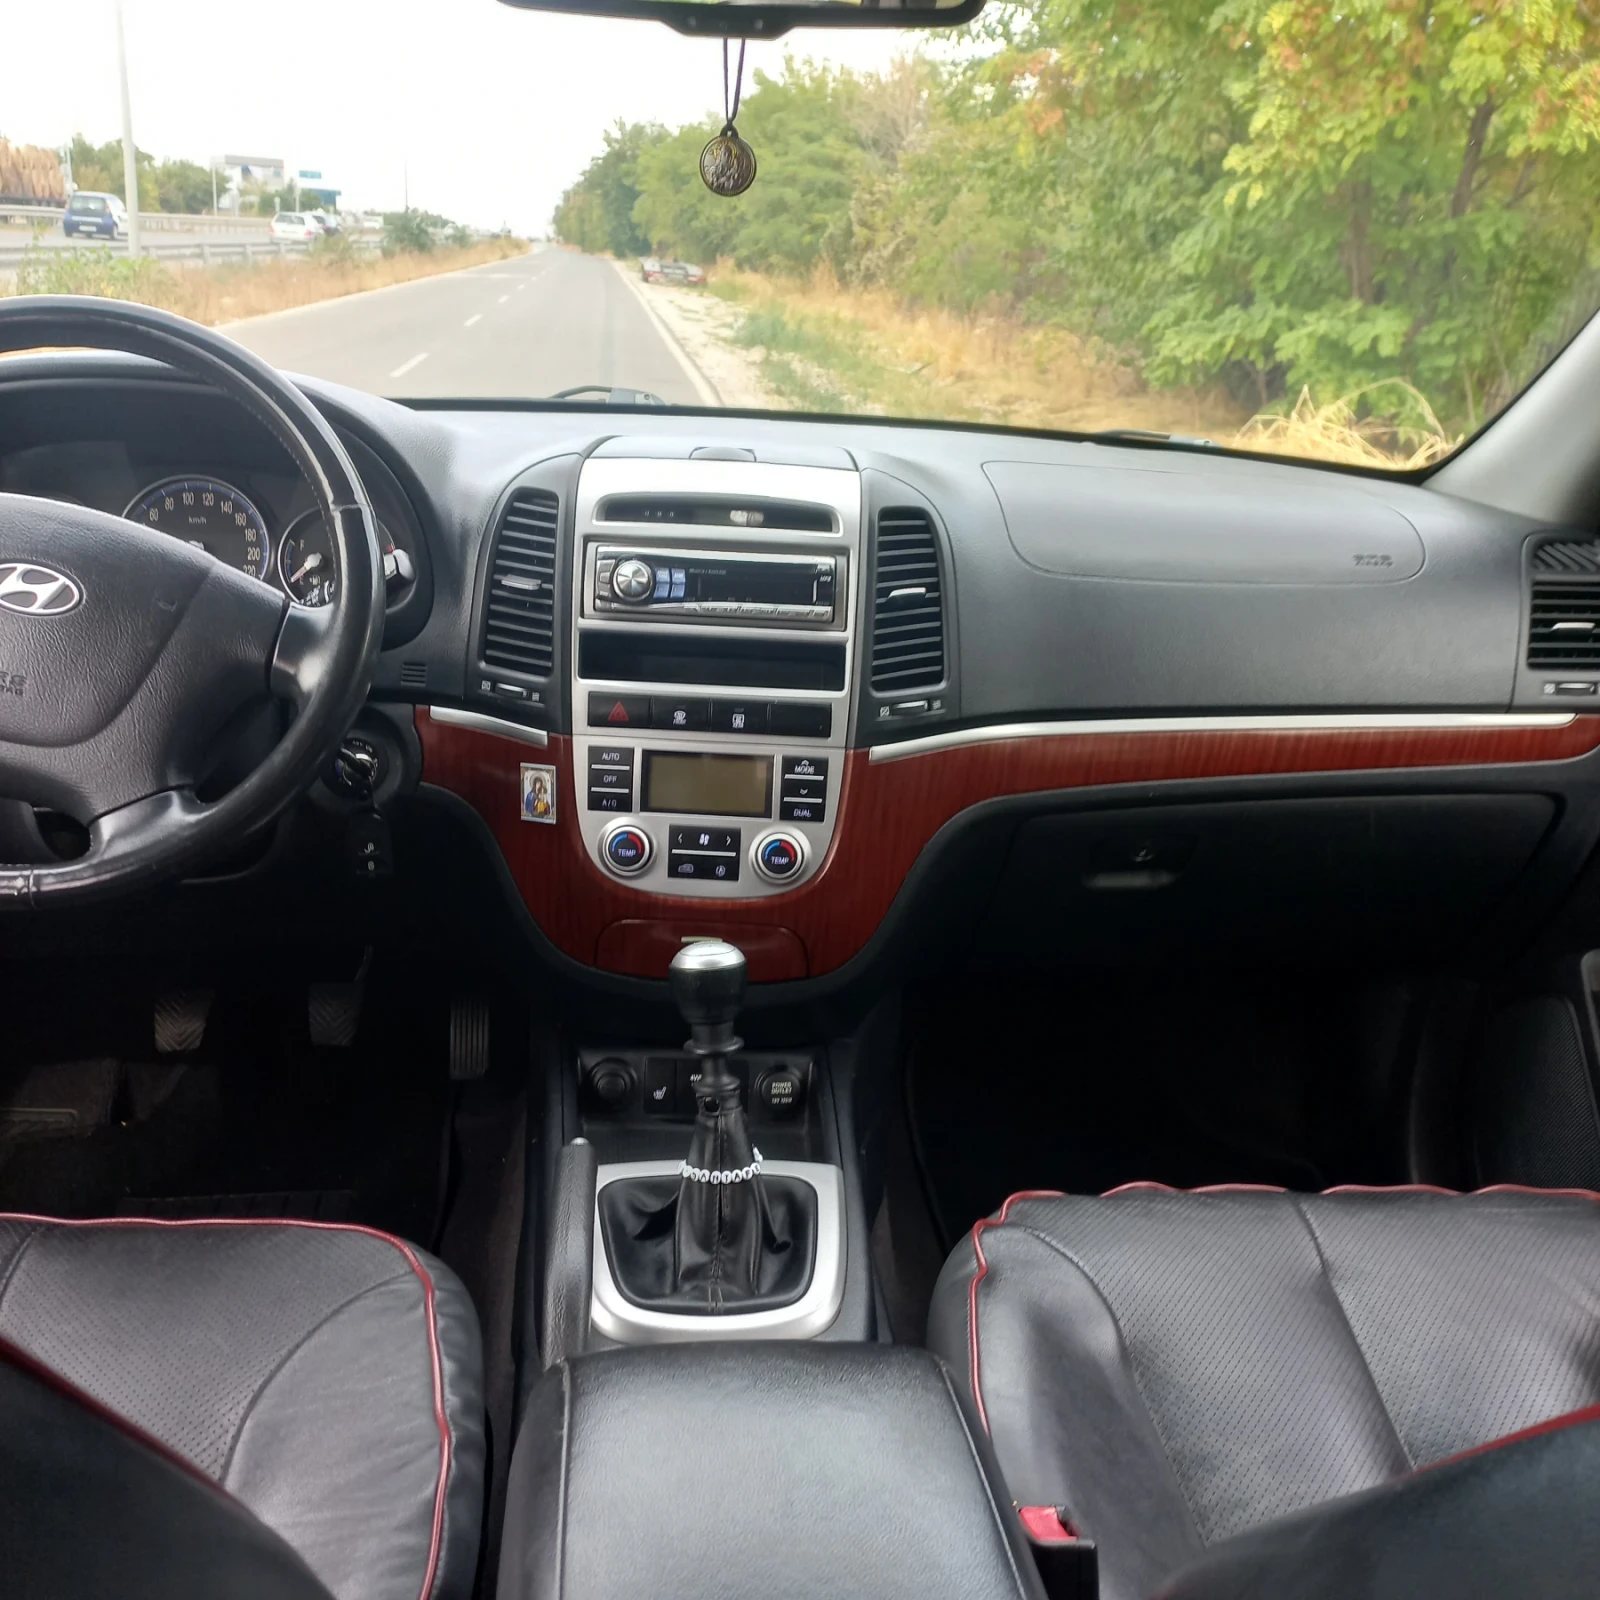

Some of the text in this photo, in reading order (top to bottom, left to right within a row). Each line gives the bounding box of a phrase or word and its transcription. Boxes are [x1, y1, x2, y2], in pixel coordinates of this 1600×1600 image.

[165, 497, 174, 511] 80
[182, 492, 194, 506] 100
[202, 493, 214, 506] 120
[221, 501, 232, 515] 140
[149, 508, 159, 521] 60
[235, 512, 246, 526] 160
[188, 516, 207, 525] km/h
[245, 528, 256, 542] 180
[247, 547, 260, 561] 200
[601, 751, 620, 761] AUTO
[794, 764, 815, 775] MODE
[603, 774, 617, 783] OFF
[793, 808, 812, 818] DUAL
[618, 847, 636, 857] TEMP
[771, 855, 789, 865] TEMP
[772, 1081, 792, 1089] POWER
[771, 1087, 792, 1095] OUTLET
